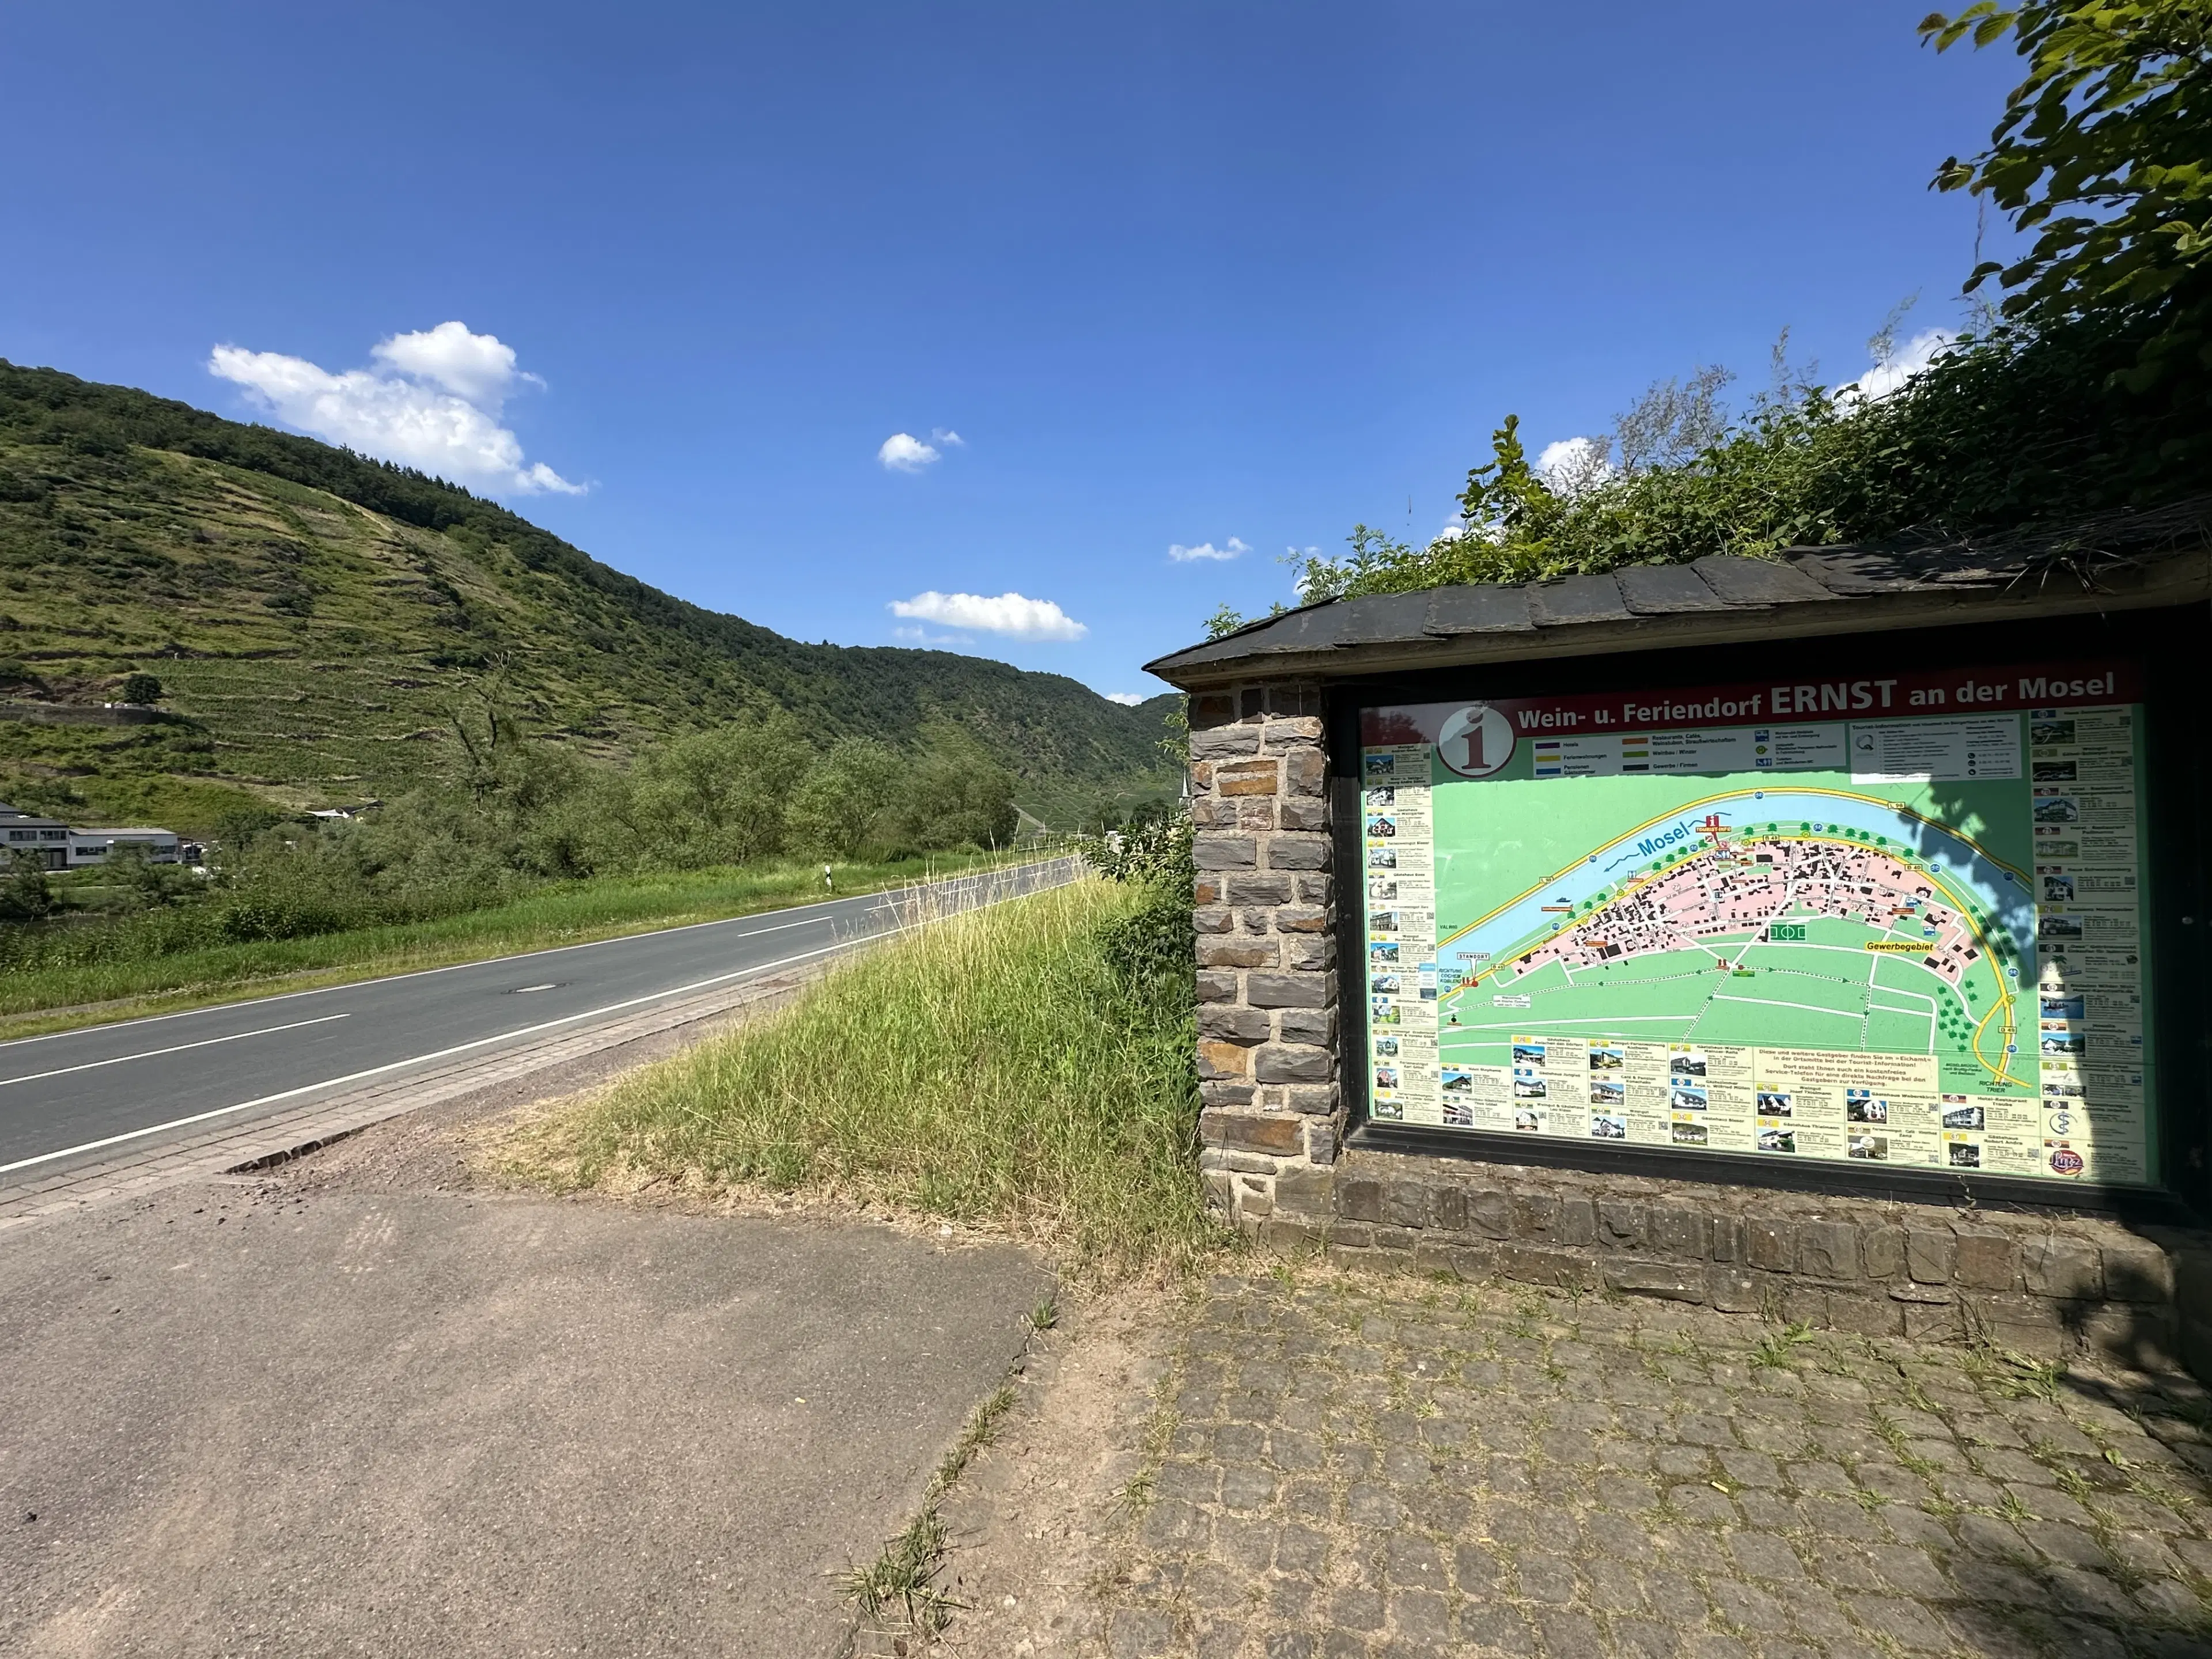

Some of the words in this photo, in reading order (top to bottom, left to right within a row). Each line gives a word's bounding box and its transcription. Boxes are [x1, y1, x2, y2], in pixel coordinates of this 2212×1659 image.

[1518, 708, 1586, 728] Wein-
[1594, 710, 1616, 724] u.
[1623, 695, 1762, 723] Feriendorf
[1771, 680, 1897, 714] ERNST
[1909, 685, 1945, 706] an
[1955, 681, 2009, 703] der
[2018, 672, 2115, 699] Mosel
[1637, 821, 1690, 857] Mosel
[1867, 942, 1933, 952] Gewerbegebiet
